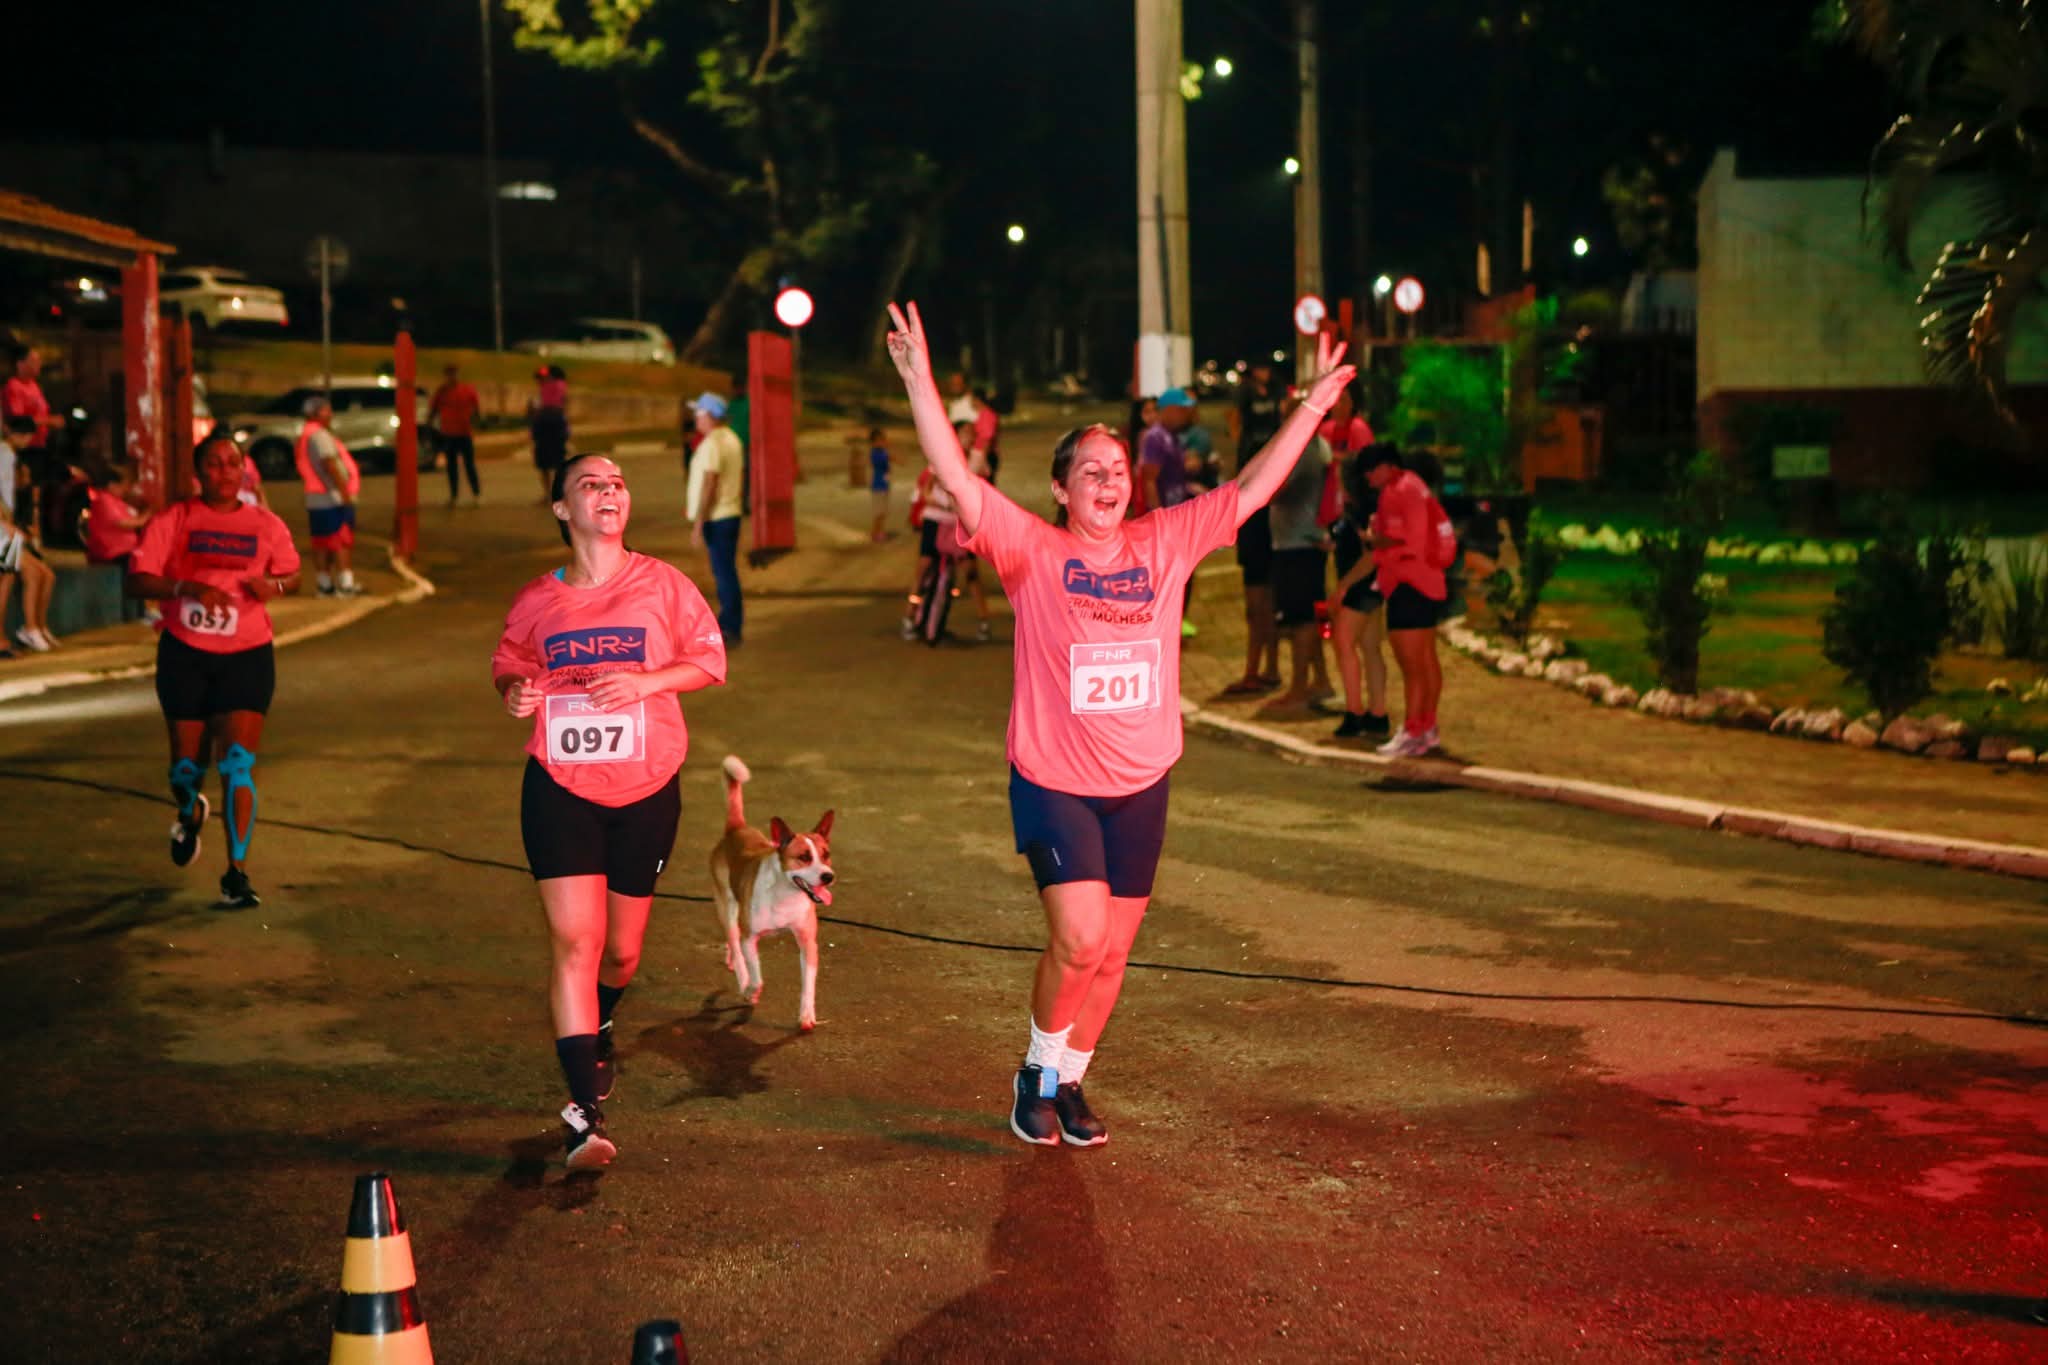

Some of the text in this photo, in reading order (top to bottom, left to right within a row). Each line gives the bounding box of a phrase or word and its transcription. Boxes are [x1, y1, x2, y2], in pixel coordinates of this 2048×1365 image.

[548, 635, 620, 662] FNR
[1092, 648, 1132, 662] FNR
[1087, 672, 1140, 703] 201
[561, 725, 624, 754] 097
